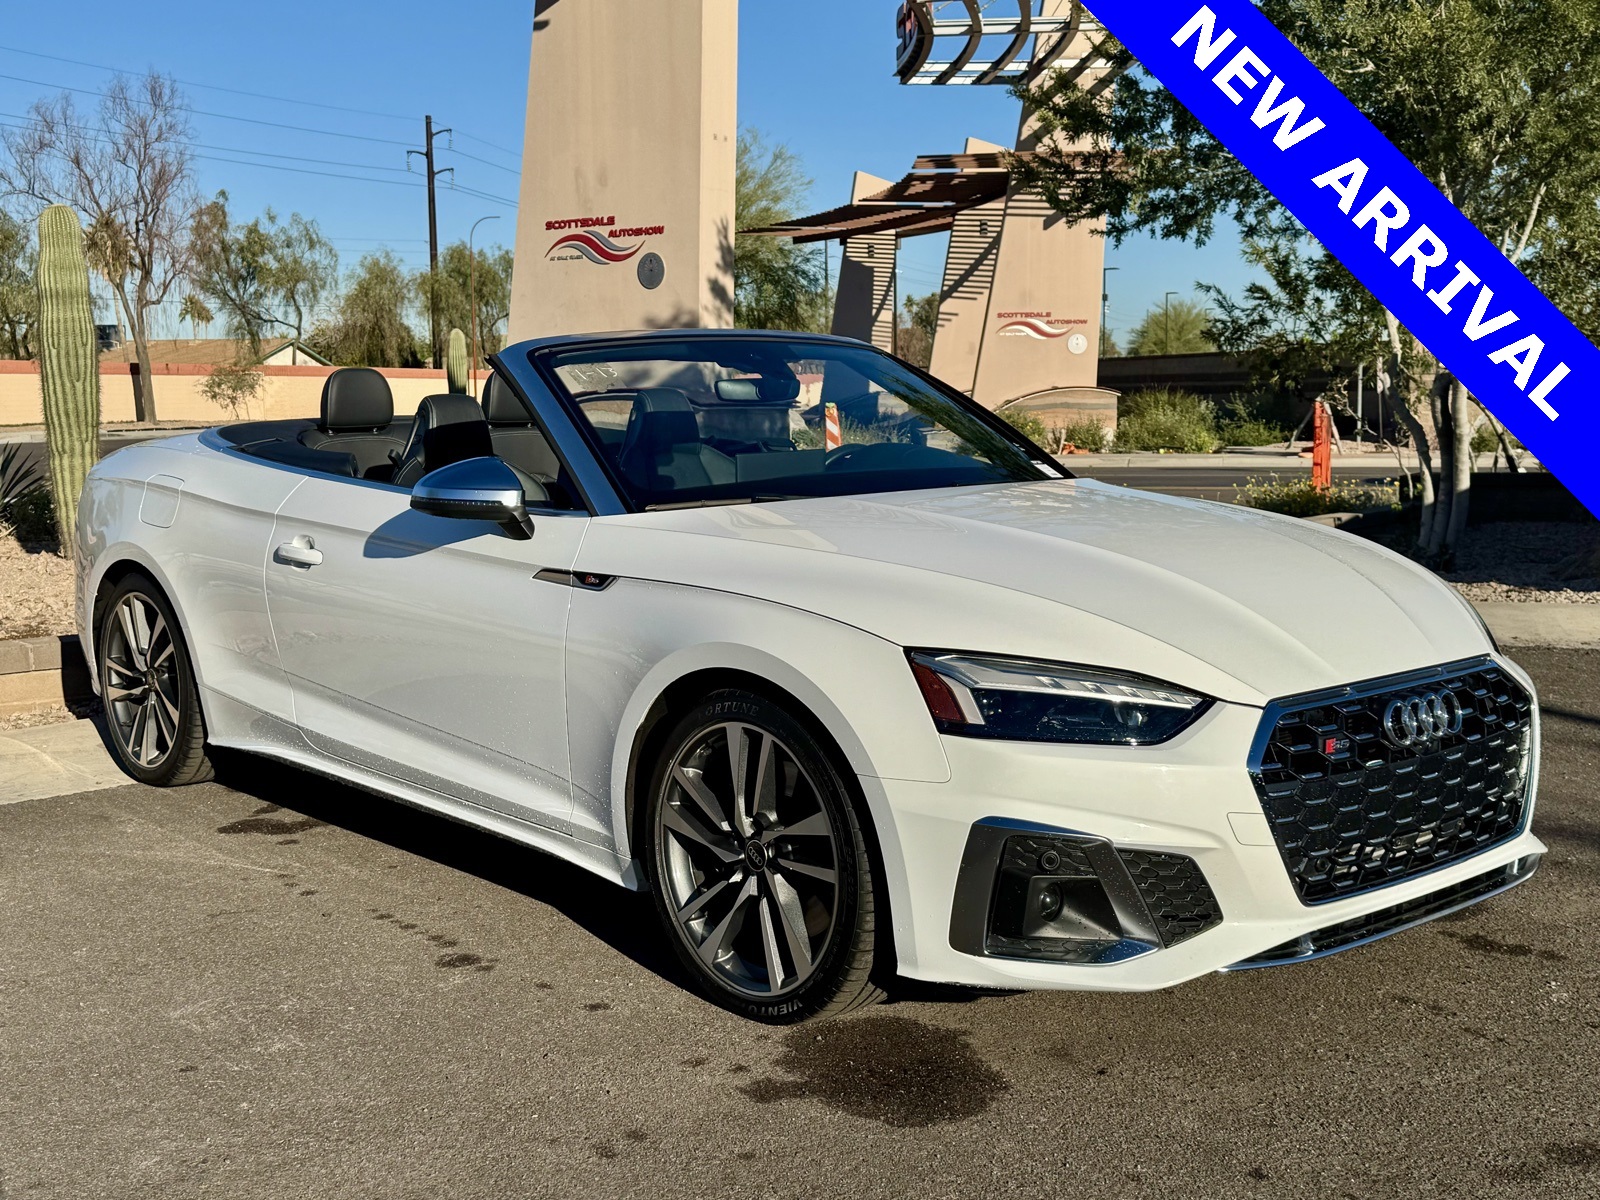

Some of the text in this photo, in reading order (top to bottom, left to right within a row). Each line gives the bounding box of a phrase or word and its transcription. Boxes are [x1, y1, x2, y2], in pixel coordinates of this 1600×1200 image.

[545, 215, 615, 231] SCOTTSDALE
[608, 225, 665, 238] AUTOSHOW
[699, 701, 760, 718] ORTUNE
[748, 998, 803, 1016] VIENTO
